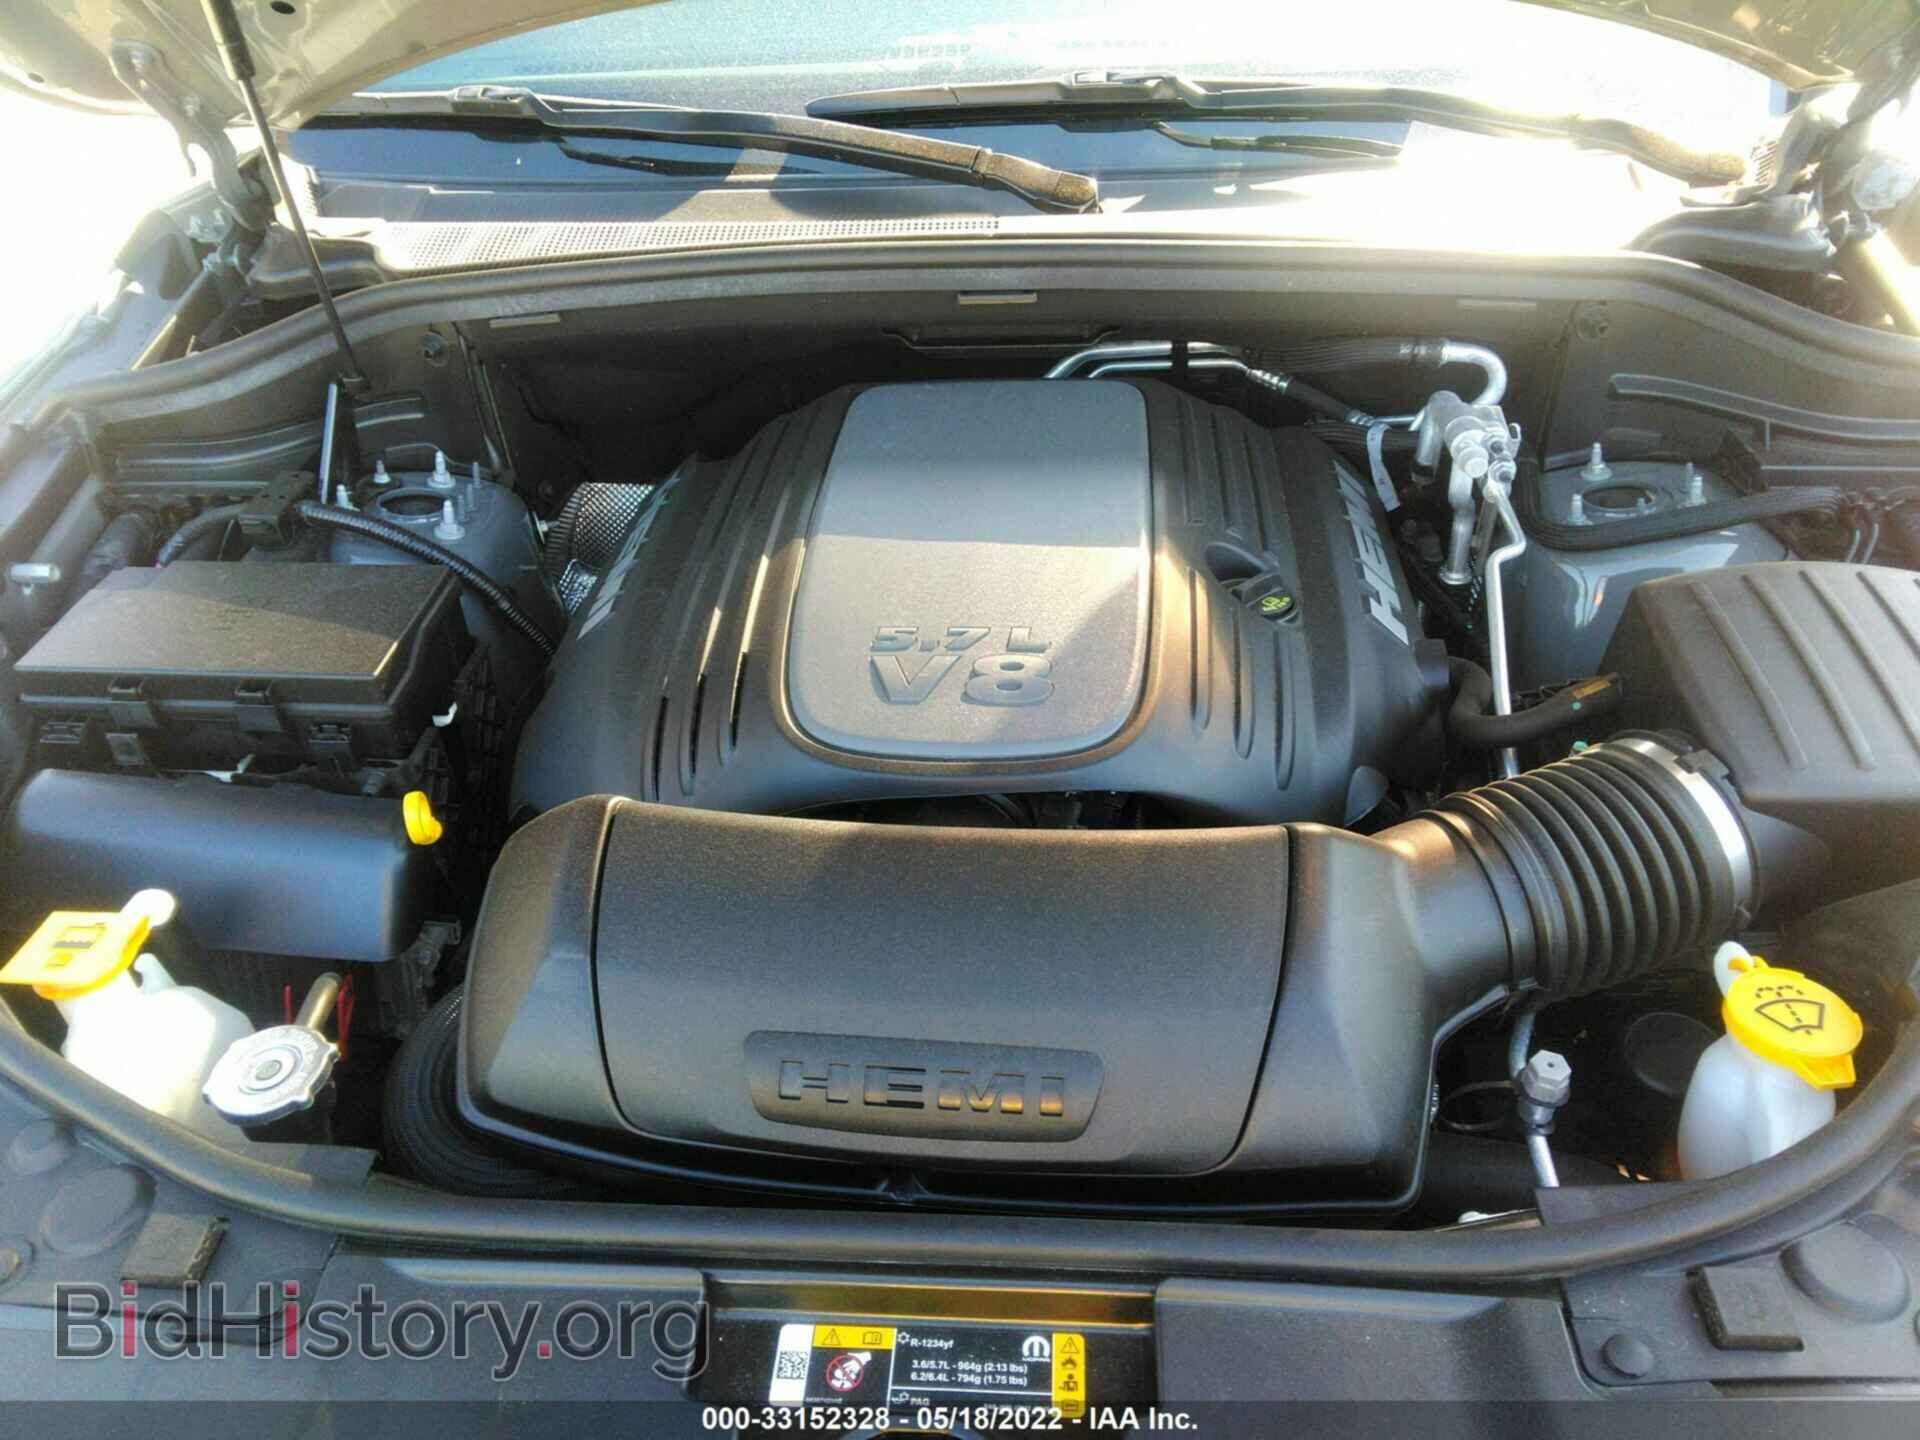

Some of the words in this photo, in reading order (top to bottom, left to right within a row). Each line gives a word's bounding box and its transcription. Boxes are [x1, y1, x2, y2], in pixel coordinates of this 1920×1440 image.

[870, 626, 1052, 653] 5.7L
[869, 654, 1055, 707] V8
[778, 1060, 1065, 1116] HEMI
[910, 1338, 955, 1350] R-1234yf
